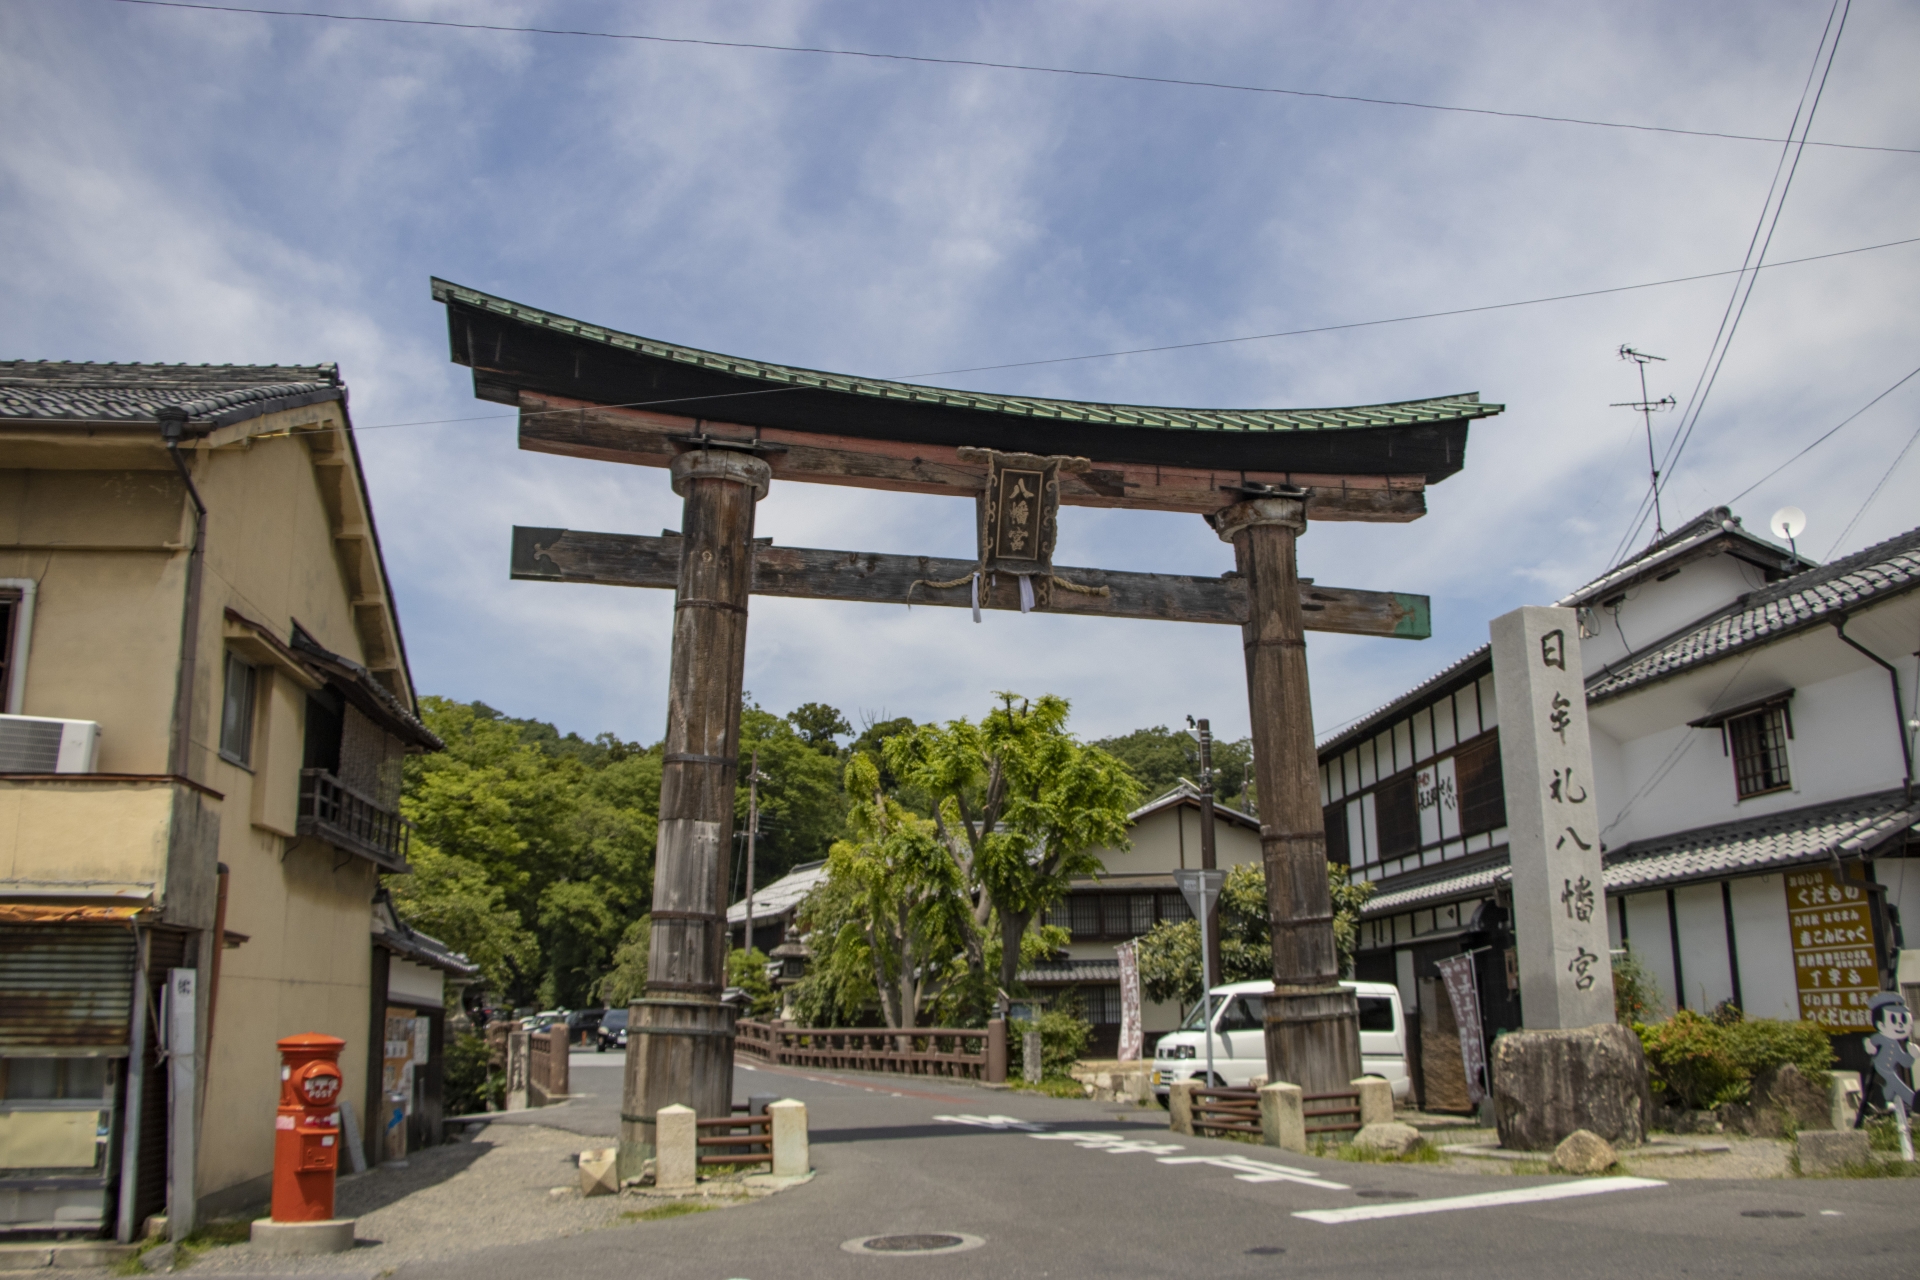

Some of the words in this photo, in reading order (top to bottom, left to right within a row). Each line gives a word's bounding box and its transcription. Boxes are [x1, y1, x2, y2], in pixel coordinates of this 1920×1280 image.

[1008, 477, 1035, 552] 八幡宮
[1540, 629, 1599, 992] 日牟礼八幡宮
[1798, 885, 1859, 905] くだもの
[308, 1089, 333, 1099] POST
